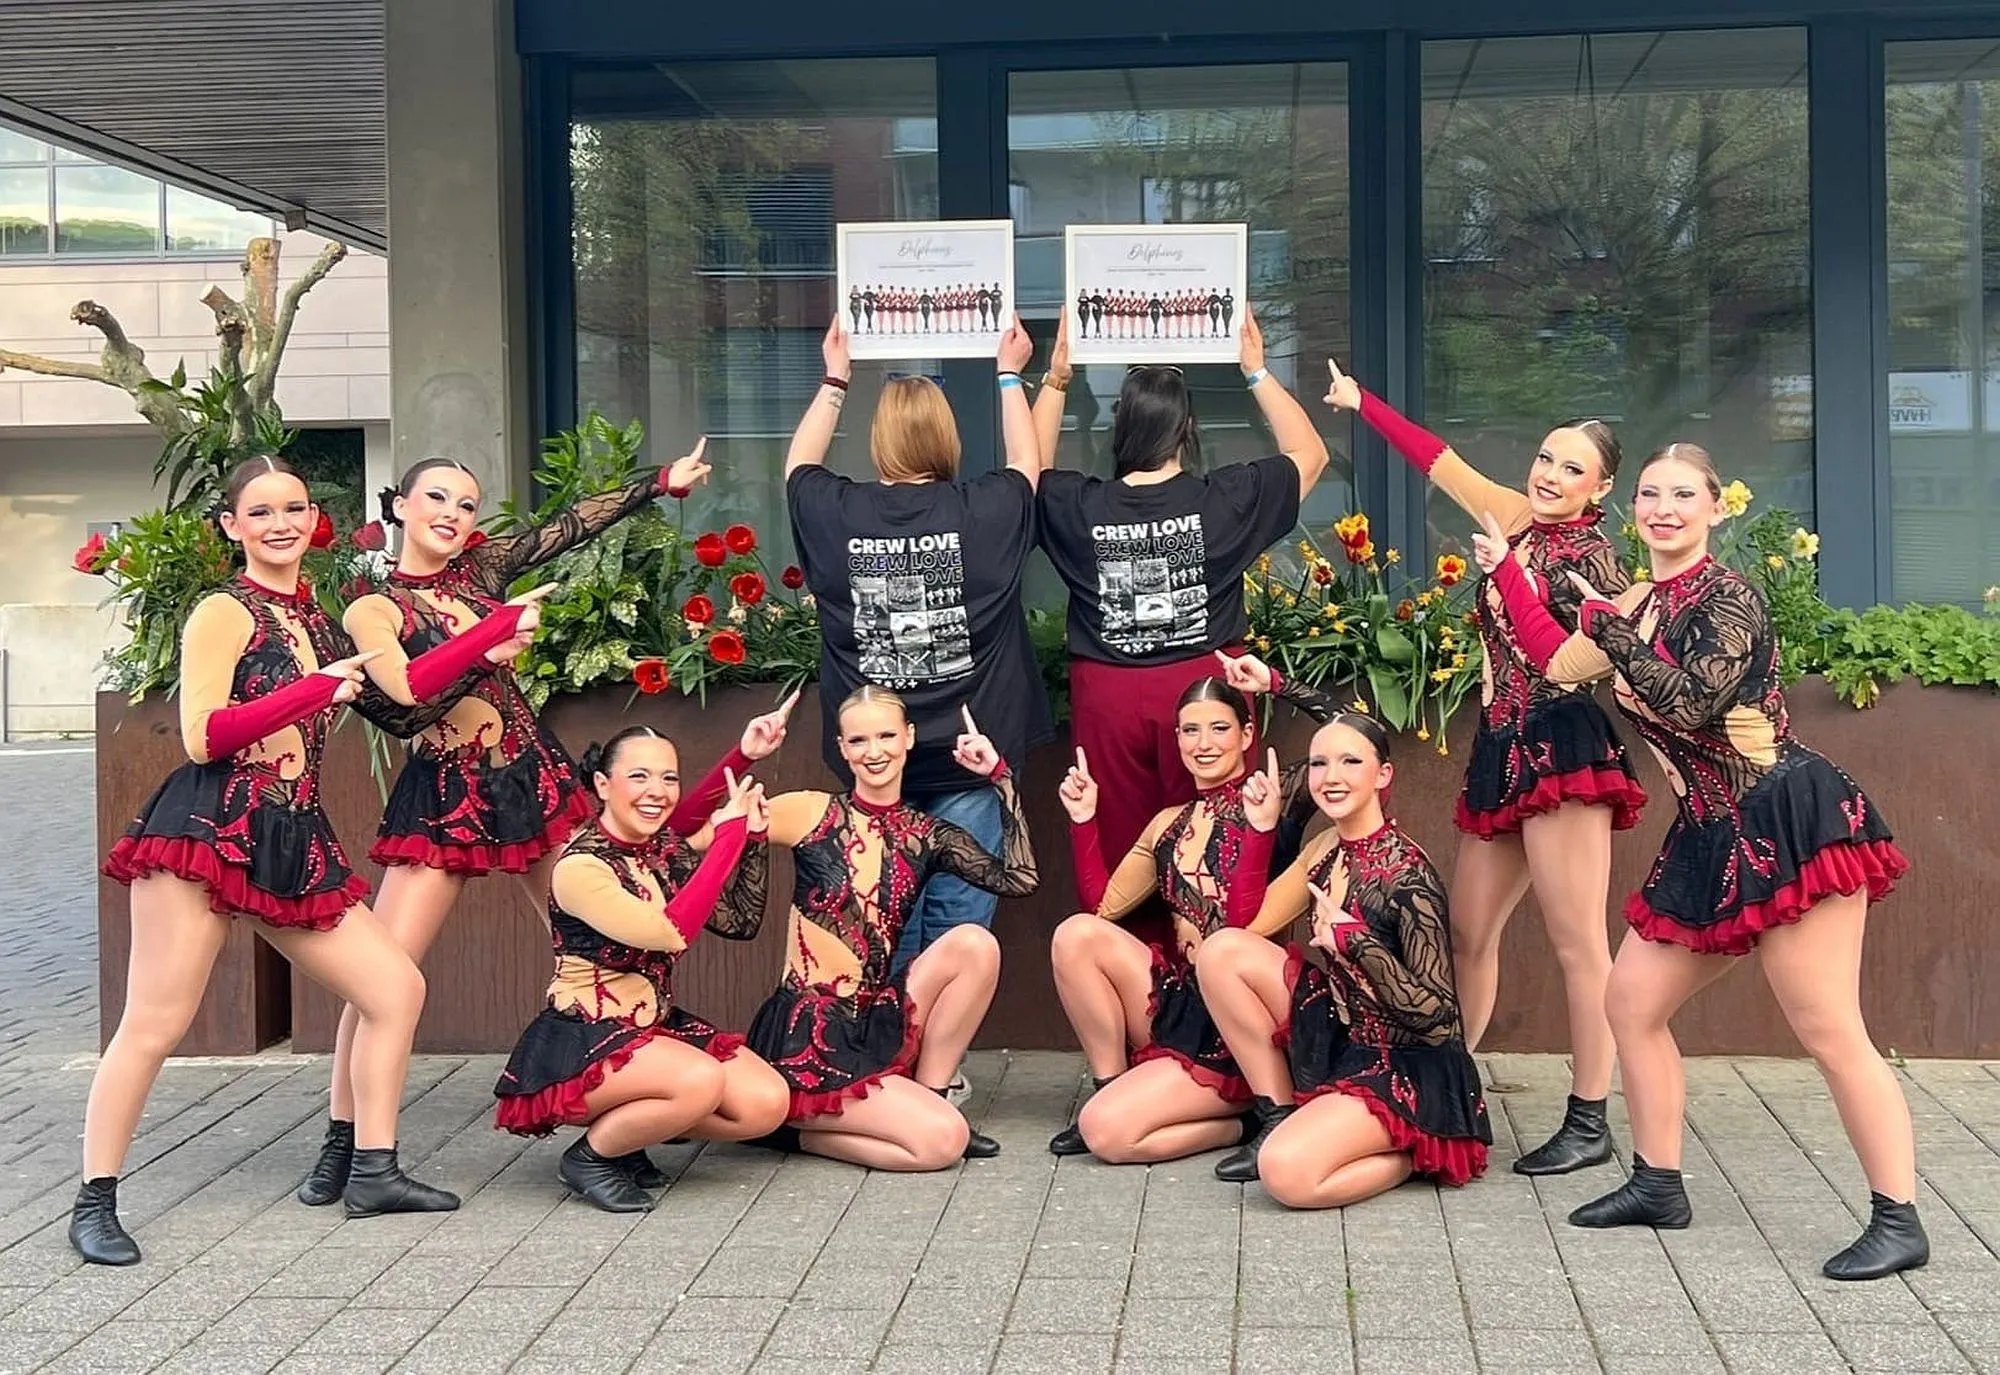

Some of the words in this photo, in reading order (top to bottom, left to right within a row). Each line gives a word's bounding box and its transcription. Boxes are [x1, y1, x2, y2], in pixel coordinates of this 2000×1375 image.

[1092, 523, 1148, 541] CREW
[1152, 513, 1202, 537] LOVE
[848, 537, 905, 554] CREW
[909, 532, 960, 552] LOVE
[1094, 538, 1151, 556] CREW
[1153, 530, 1204, 554] LOVE
[849, 554, 908, 571] CREW
[910, 549, 963, 570] LOVE
[1154, 547, 1206, 567] OVE
[912, 567, 964, 586] OVE
